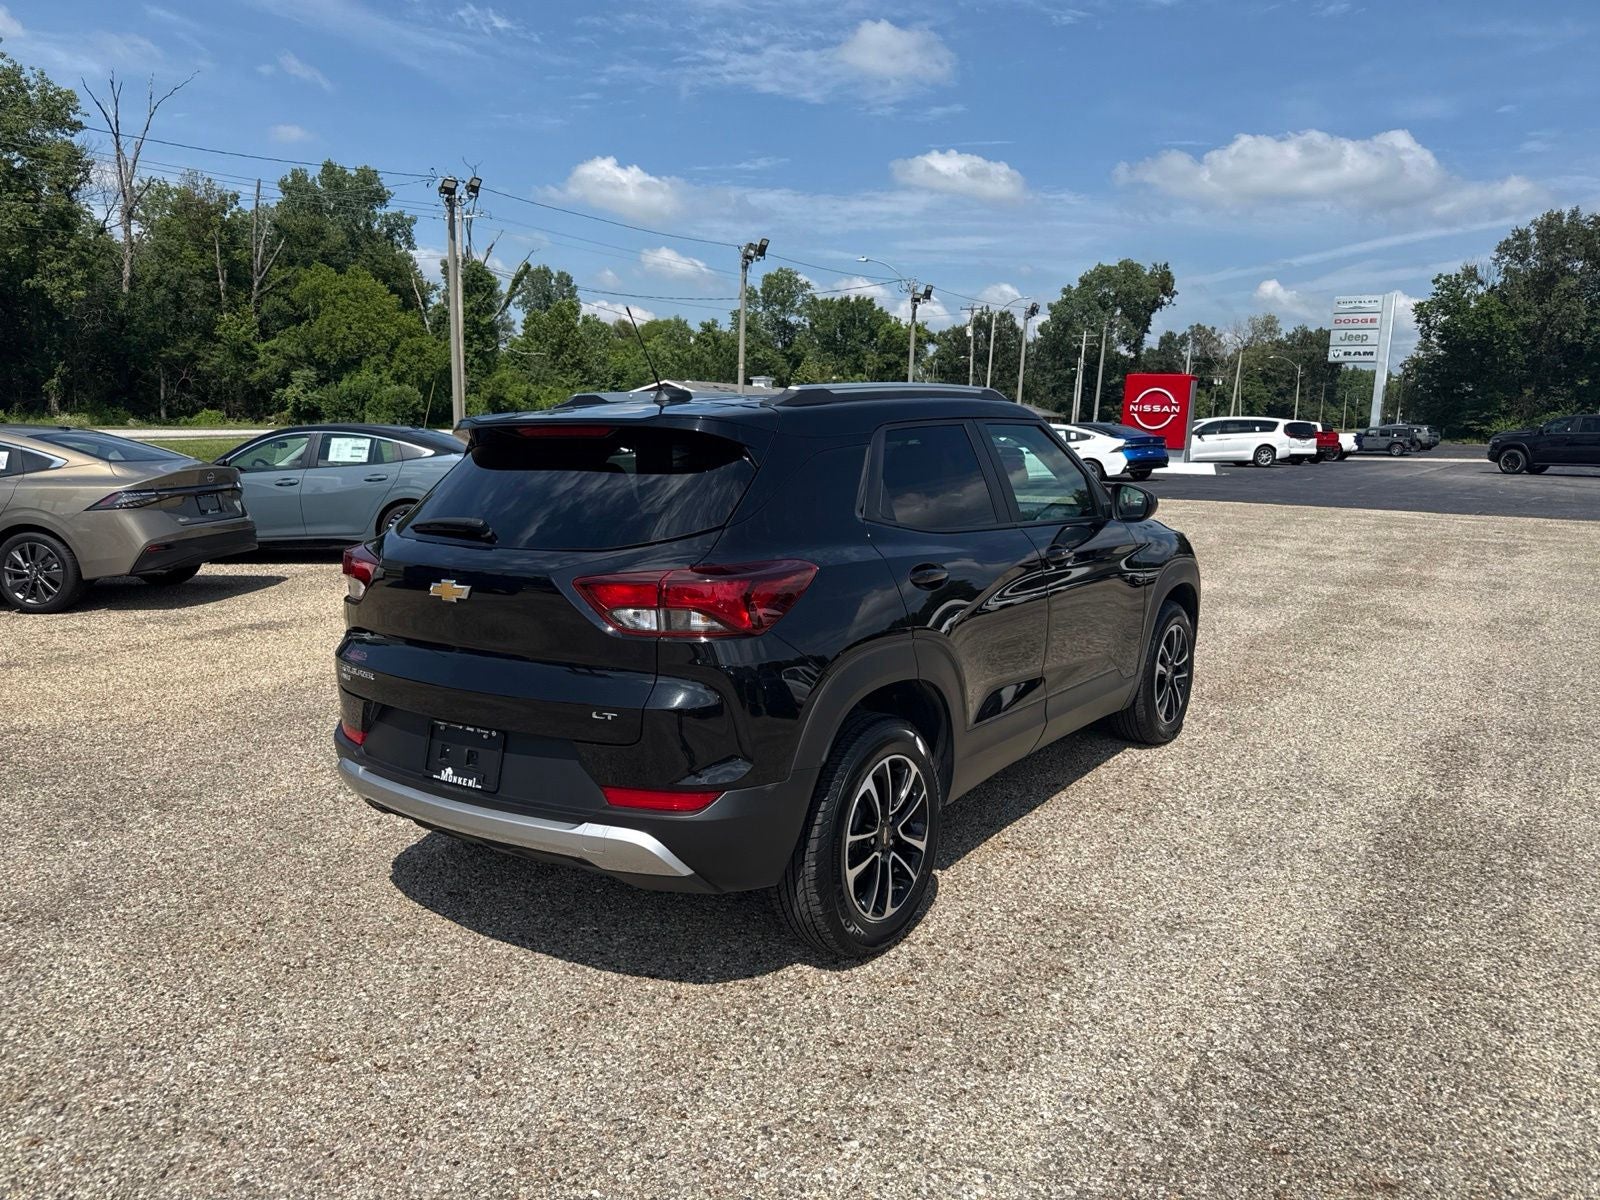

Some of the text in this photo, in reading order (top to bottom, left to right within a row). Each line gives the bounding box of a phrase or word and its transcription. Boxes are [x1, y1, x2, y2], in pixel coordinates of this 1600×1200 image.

[1334, 317, 1377, 325] DODGE
[1339, 332, 1369, 343] Jeep
[1129, 404, 1181, 413] NISSAN
[591, 711, 618, 721] LT
